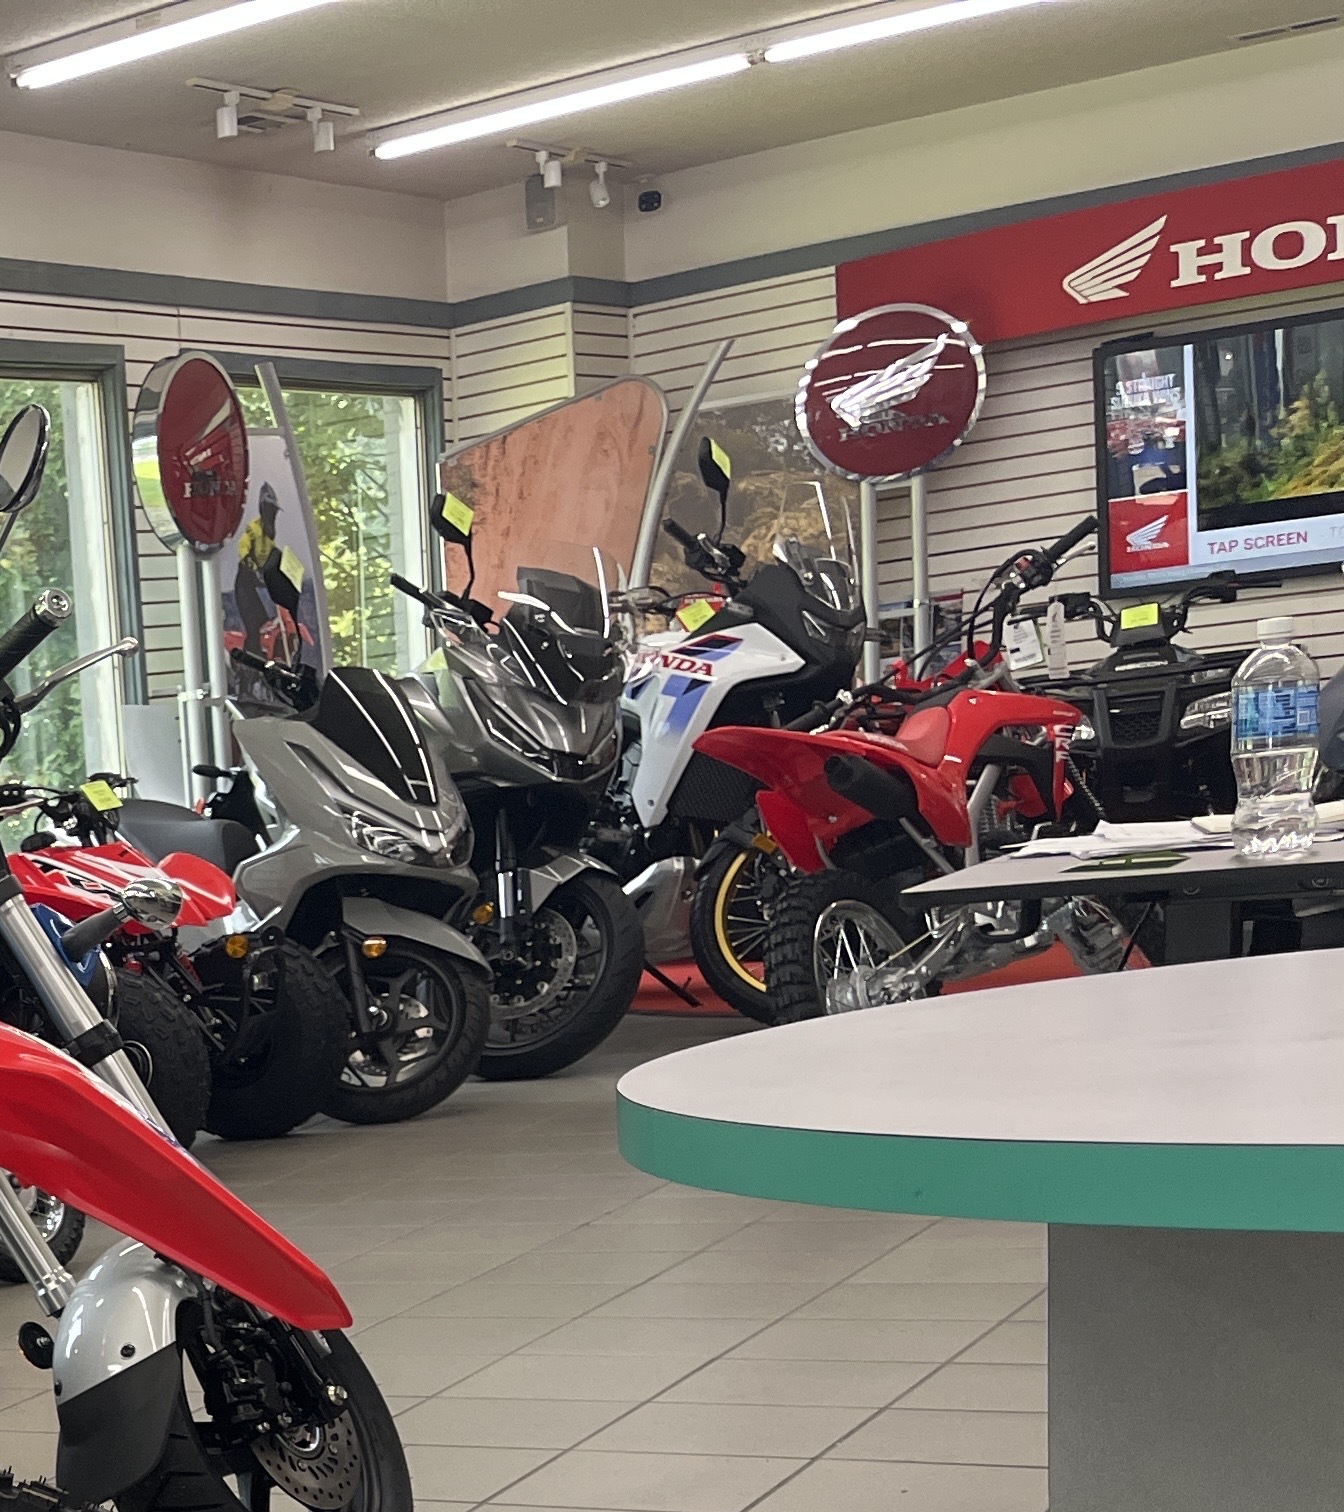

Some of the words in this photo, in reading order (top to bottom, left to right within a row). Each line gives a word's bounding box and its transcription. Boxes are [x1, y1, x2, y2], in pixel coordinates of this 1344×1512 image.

[1207, 539, 1239, 555] TAP
[1243, 531, 1308, 550] SCREEN
[1052, 724, 1074, 763] CRF
